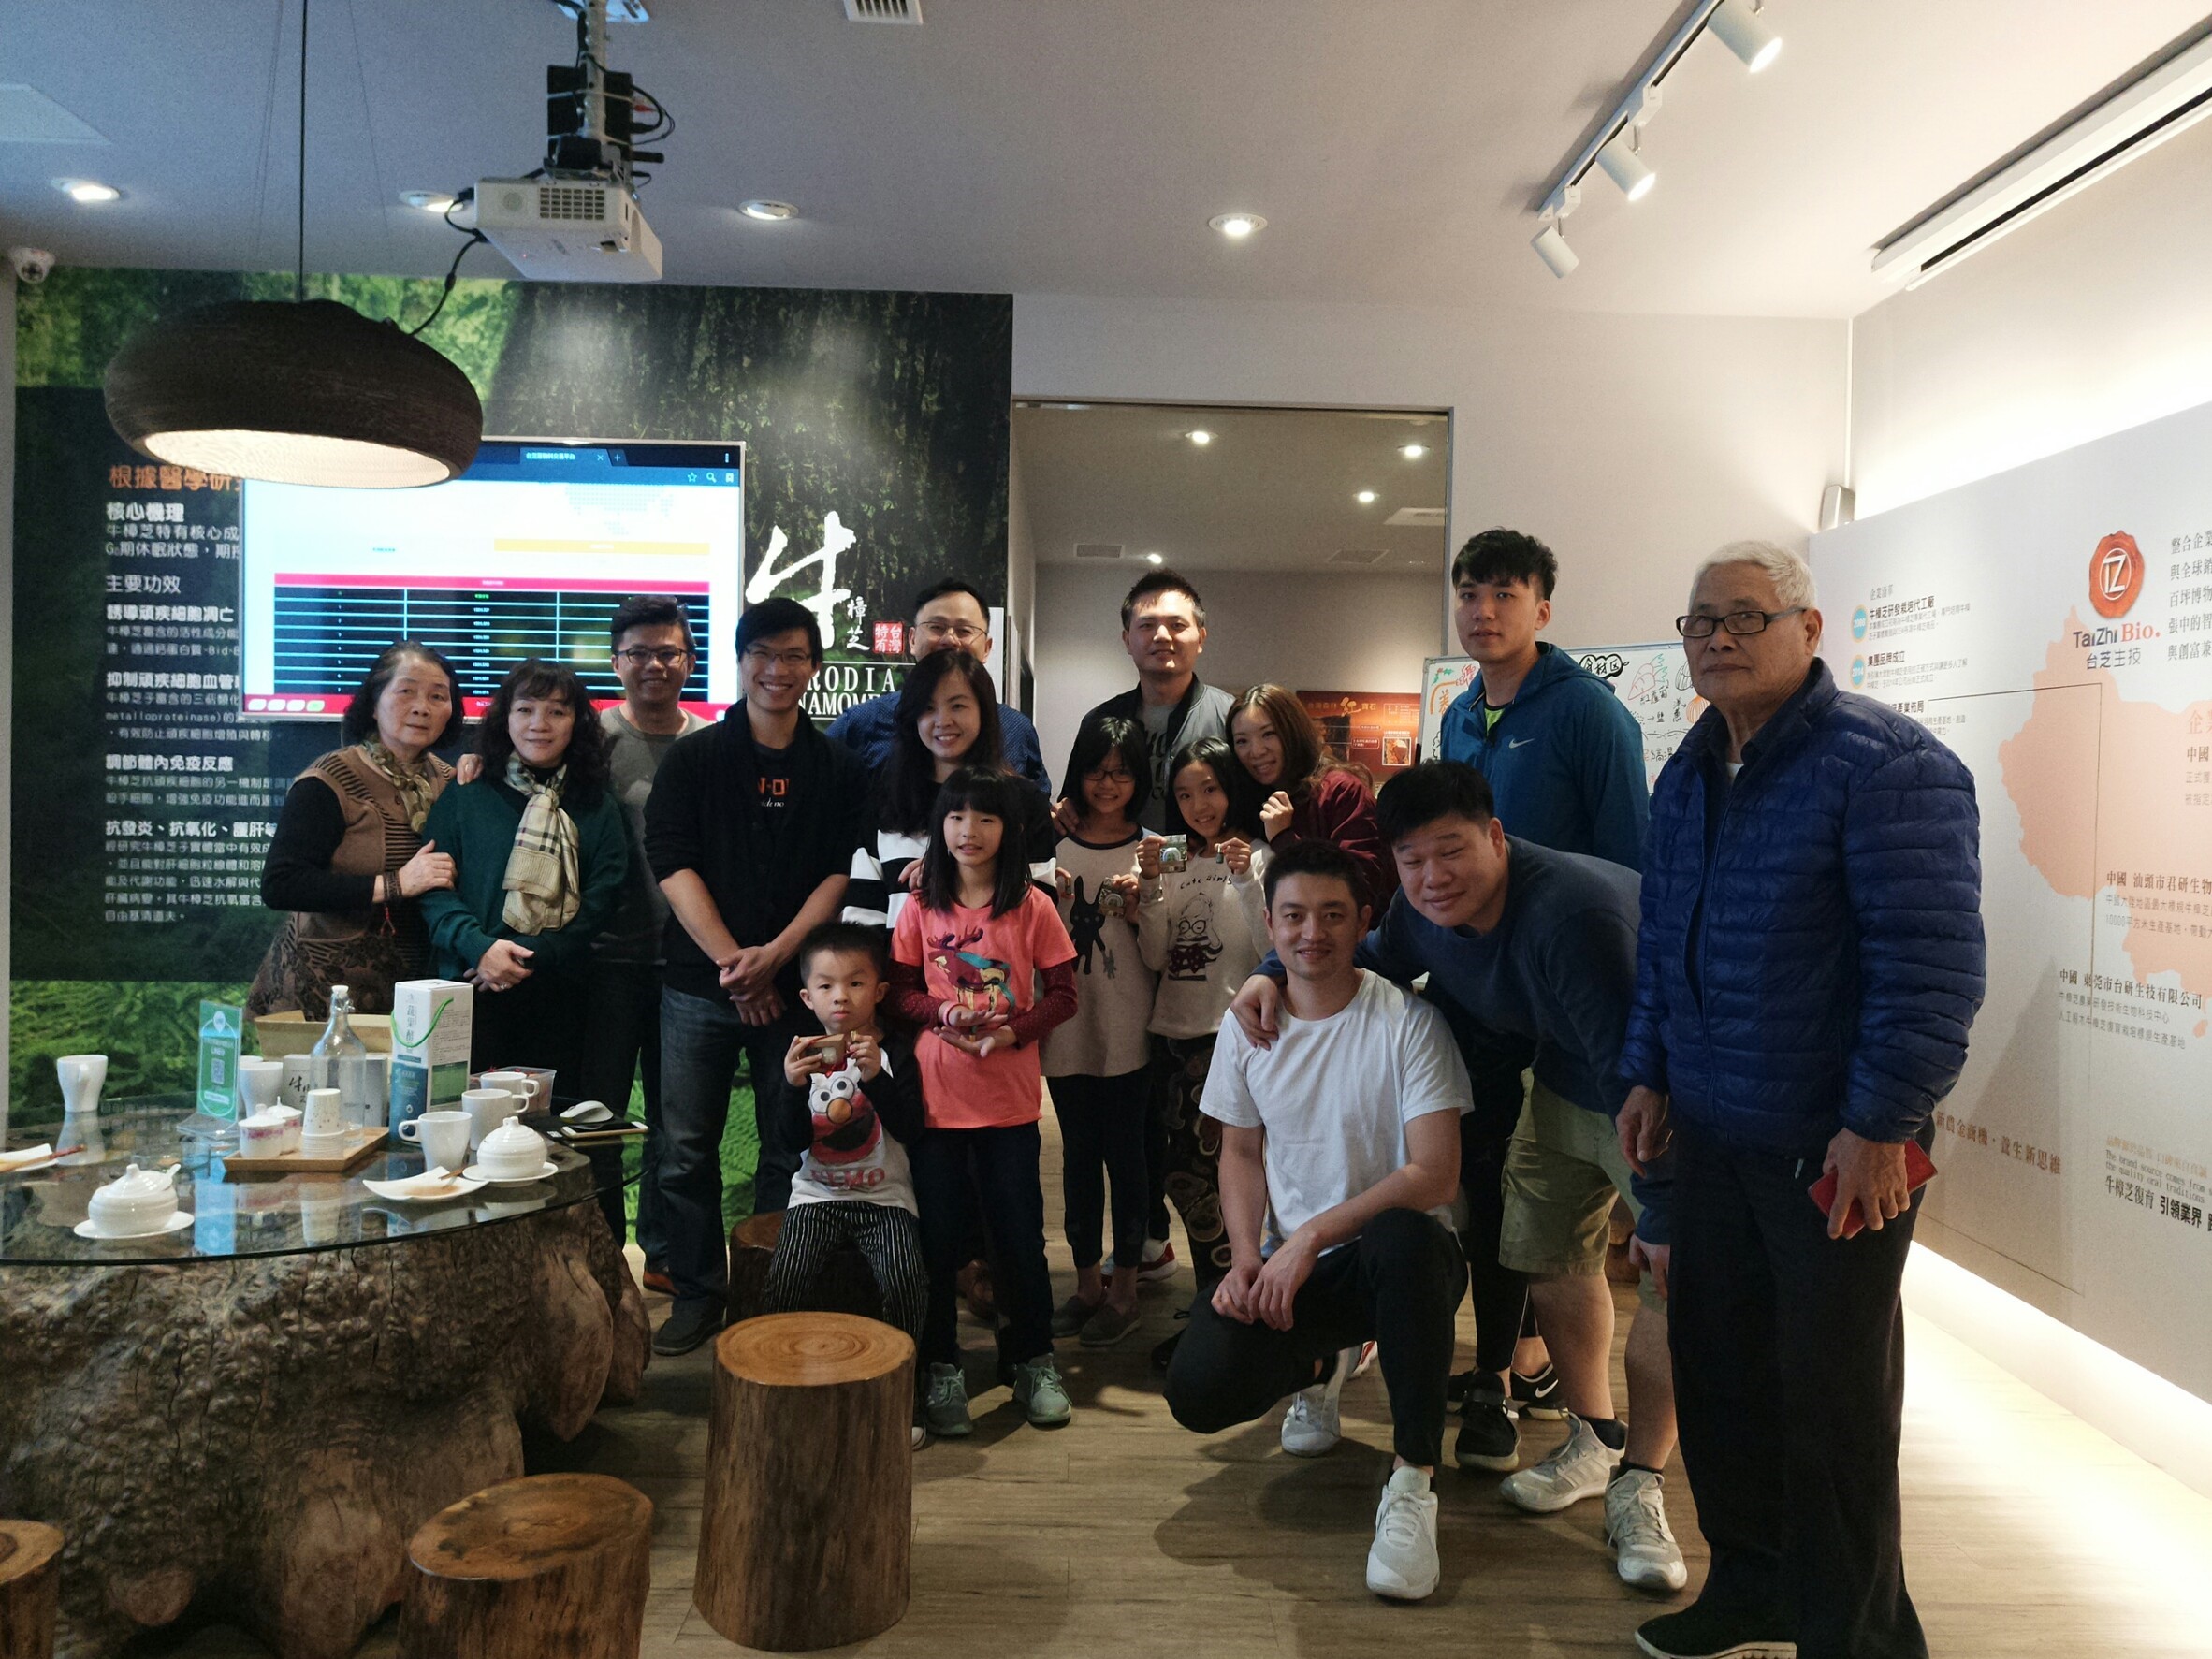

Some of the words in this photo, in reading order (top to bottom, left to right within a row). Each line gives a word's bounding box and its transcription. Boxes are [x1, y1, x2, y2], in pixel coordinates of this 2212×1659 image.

[109, 465, 240, 491] 根據醫學研
[106, 502, 184, 523] 核心機理
[105, 575, 182, 594] 主要功效
[2121, 622, 2161, 643] Bio.
[107, 671, 240, 689] 抑制頑疾細胞血管
[2187, 746, 2210, 763] 中國
[2106, 870, 2127, 887] 中國
[2059, 968, 2078, 985] 中國
[2160, 1195, 2202, 1229] 引領業界
